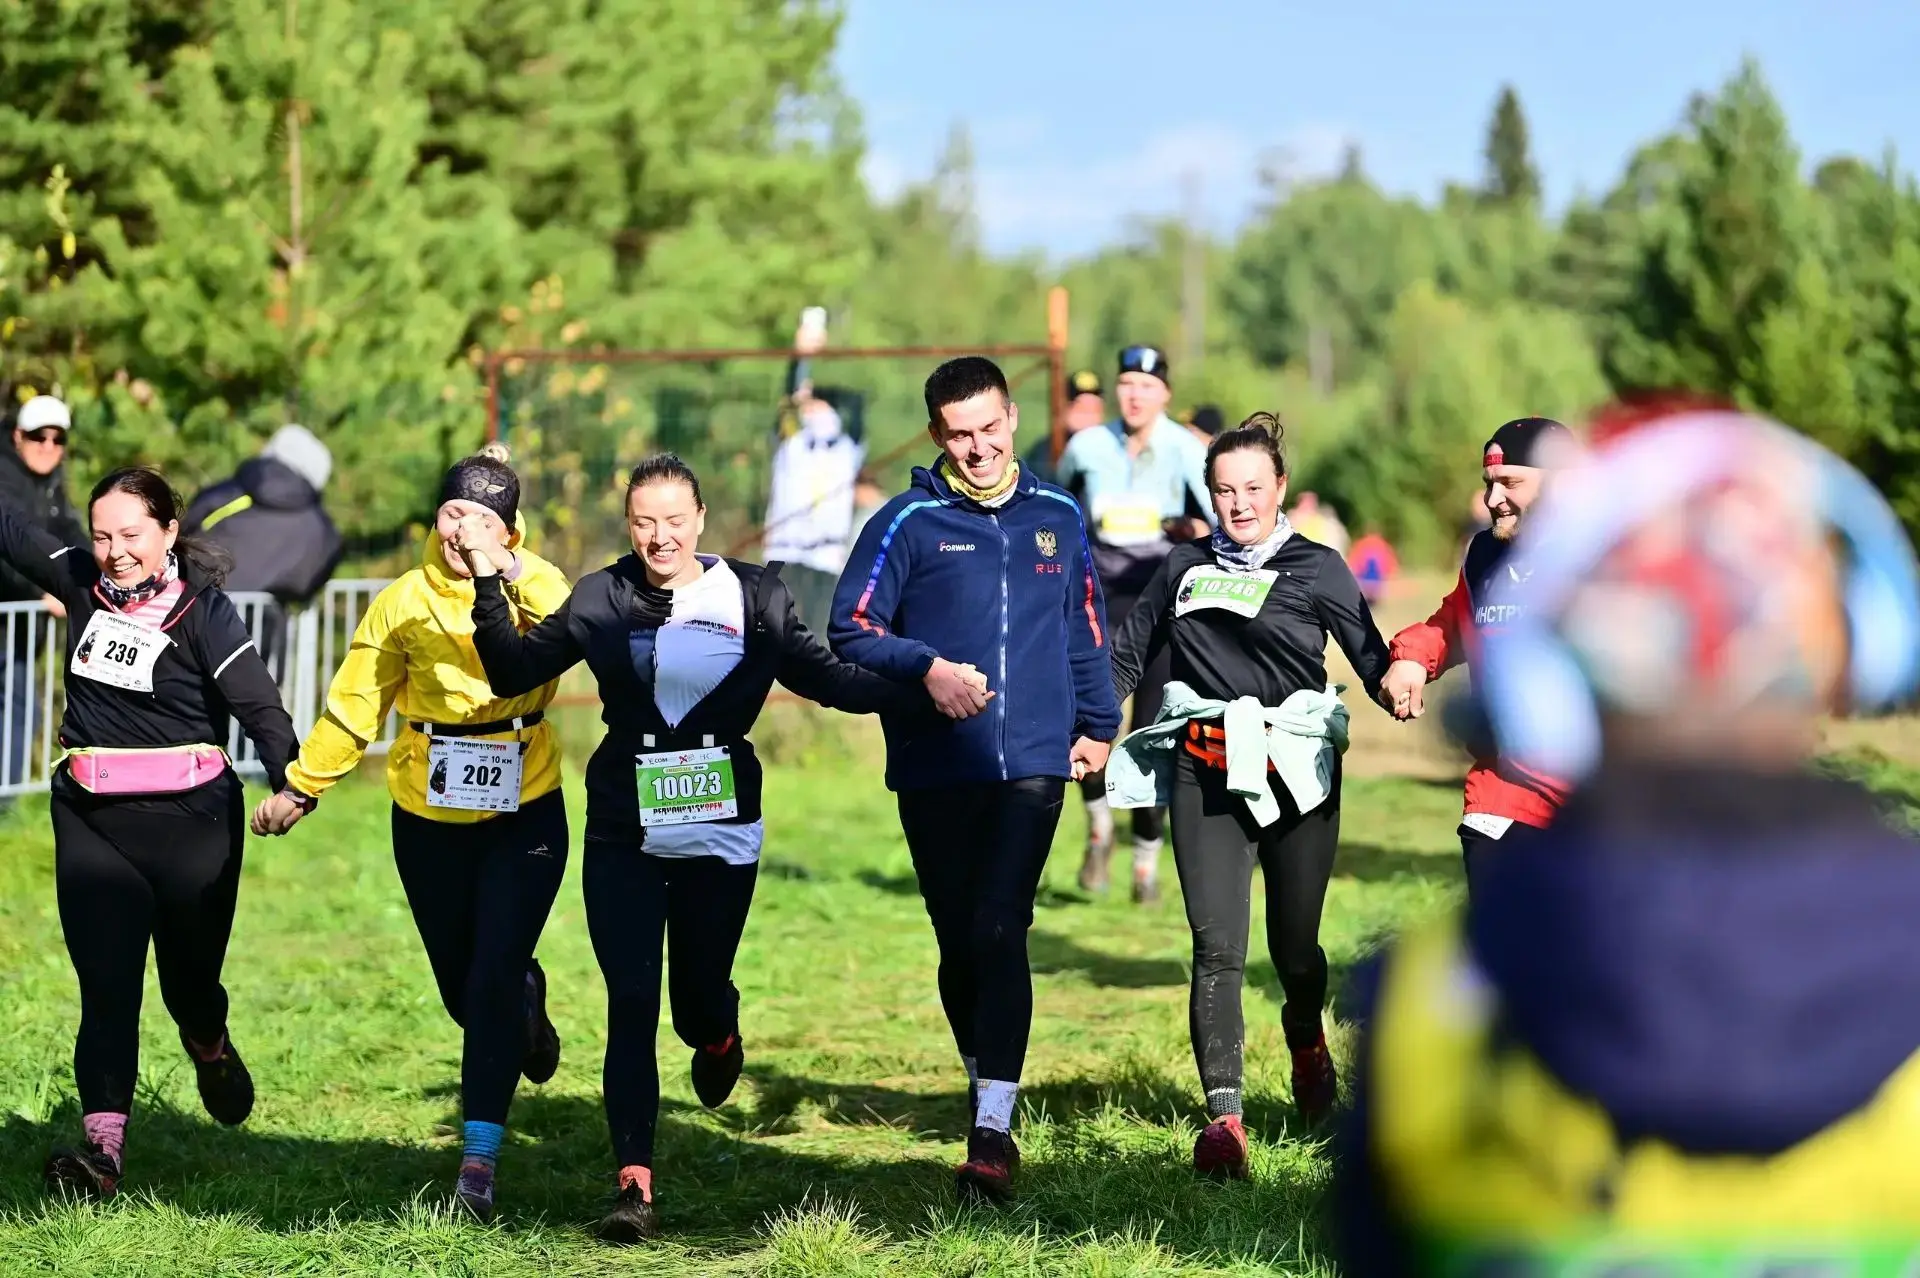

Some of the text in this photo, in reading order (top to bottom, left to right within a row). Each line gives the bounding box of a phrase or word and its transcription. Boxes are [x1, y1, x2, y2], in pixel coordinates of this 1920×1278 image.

[939, 541, 976, 552] FORWARD
[1200, 579, 1257, 597] 10246
[104, 640, 138, 667] 239
[491, 755, 500, 764] 10
[462, 764, 502, 787] 202
[651, 771, 722, 800] 10023
